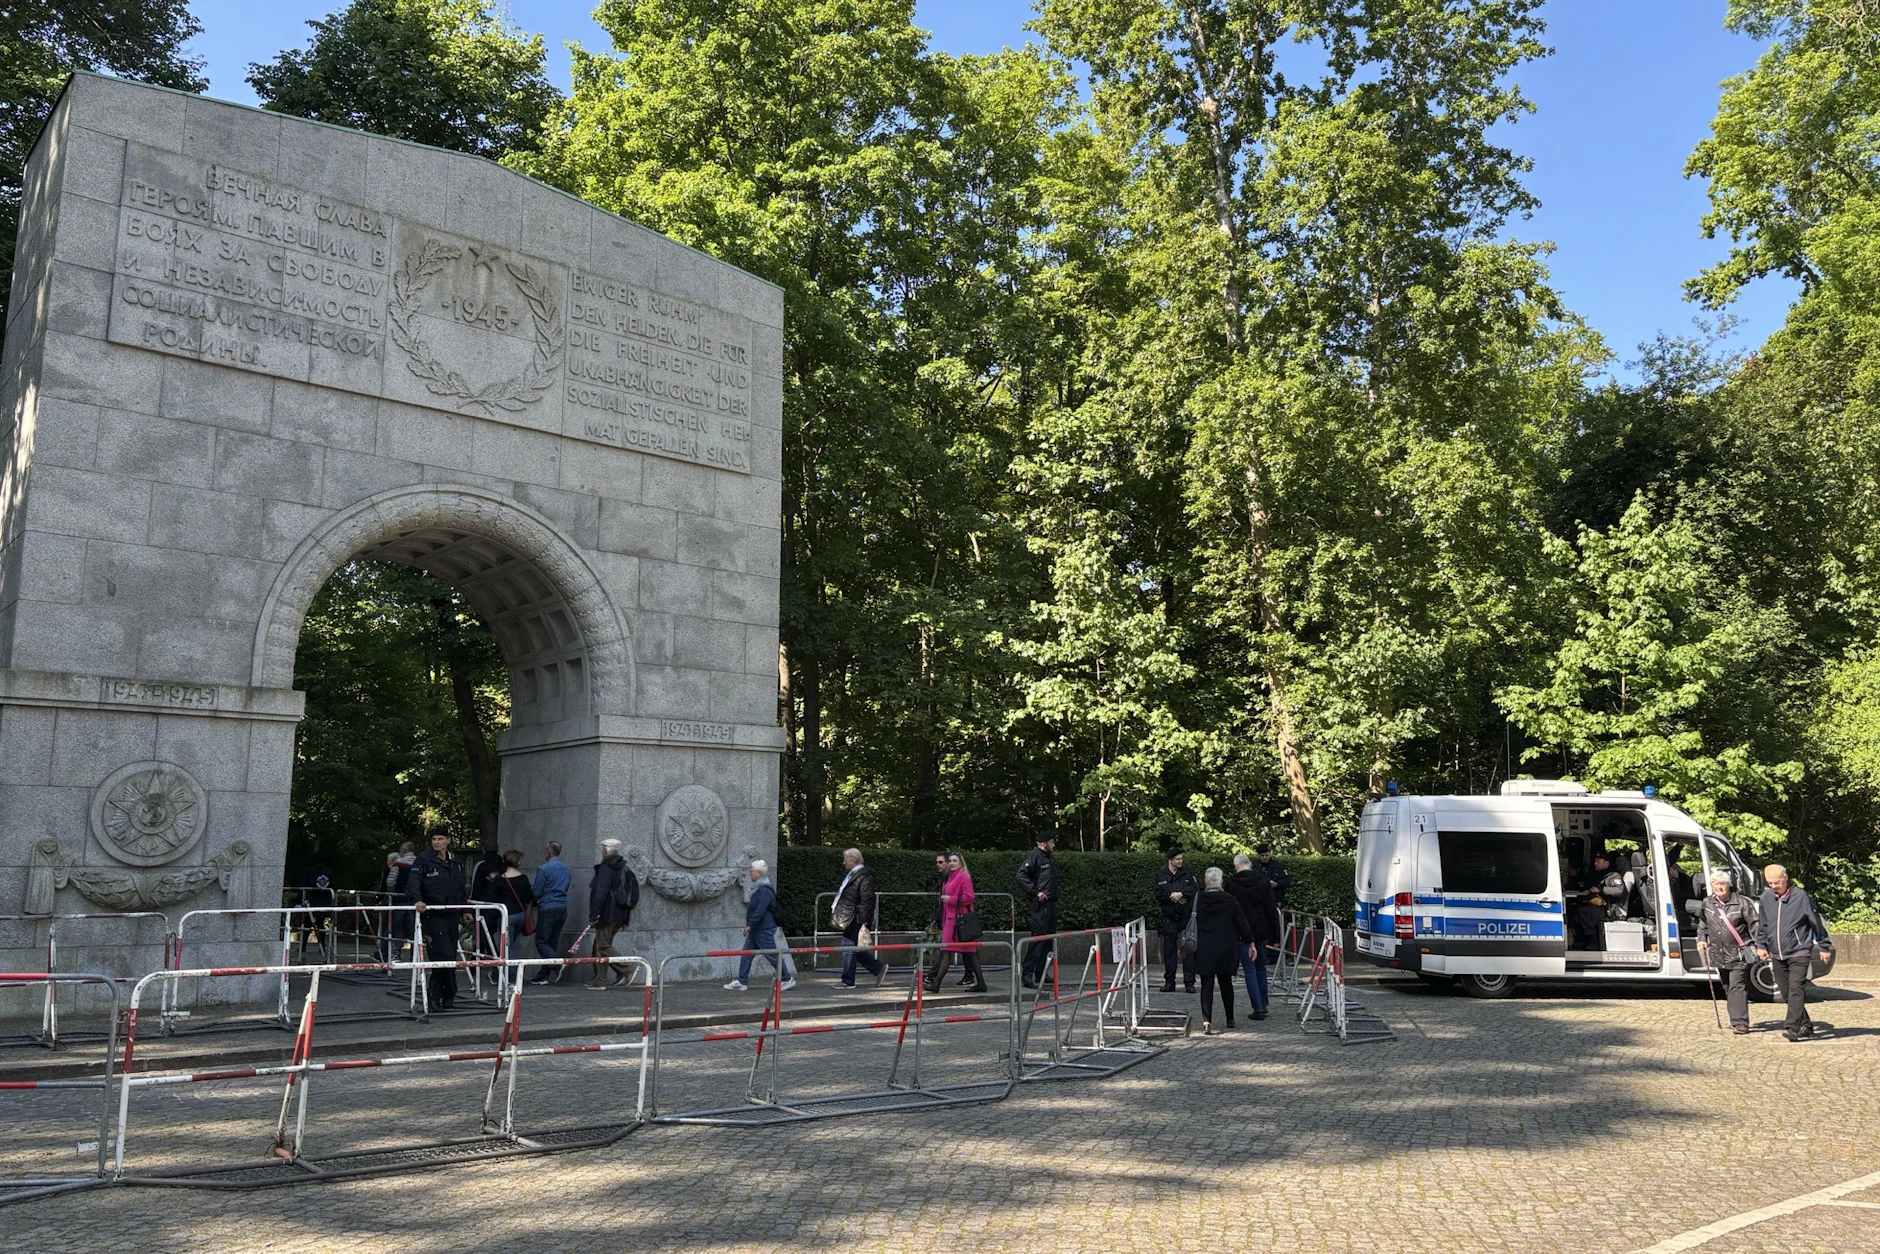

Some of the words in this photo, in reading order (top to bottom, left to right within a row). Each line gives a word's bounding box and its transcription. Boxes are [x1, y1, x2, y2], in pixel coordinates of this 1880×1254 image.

[206, 164, 302, 213] ВЕЧНАЯ
[315, 202, 387, 238] СЛАВА
[127, 214, 203, 254] БОЯХ
[219, 240, 250, 266] ЗА
[268, 252, 385, 297] СВОБОДУ
[248, 214, 358, 262] ПАВШИМ
[372, 246, 385, 267] В
[124, 254, 140, 271] И
[163, 259, 380, 329] НЕЗАВИСИМОСТЬ
[572, 273, 638, 307] EWIGER
[648, 295, 698, 324] RUHM
[122, 284, 380, 359] СОЦИАЛИСТИЧЕСКОЙ
[571, 301, 607, 327] DEN
[687, 336, 712, 355] DIE
[570, 328, 601, 352] DIE
[617, 341, 698, 376] FREIHEIT
[711, 365, 748, 389] UND
[567, 386, 708, 433] SOZIALISTISCHEN
[569, 357, 713, 407] UNABHÄNGIGKEIT
[718, 396, 748, 416] DER
[584, 418, 620, 441] MAT
[625, 429, 699, 459] GEFALLEN
[707, 445, 746, 468] SIND.
[1414, 814, 1426, 824] 21
[1478, 923, 1531, 934] POLIZEI
